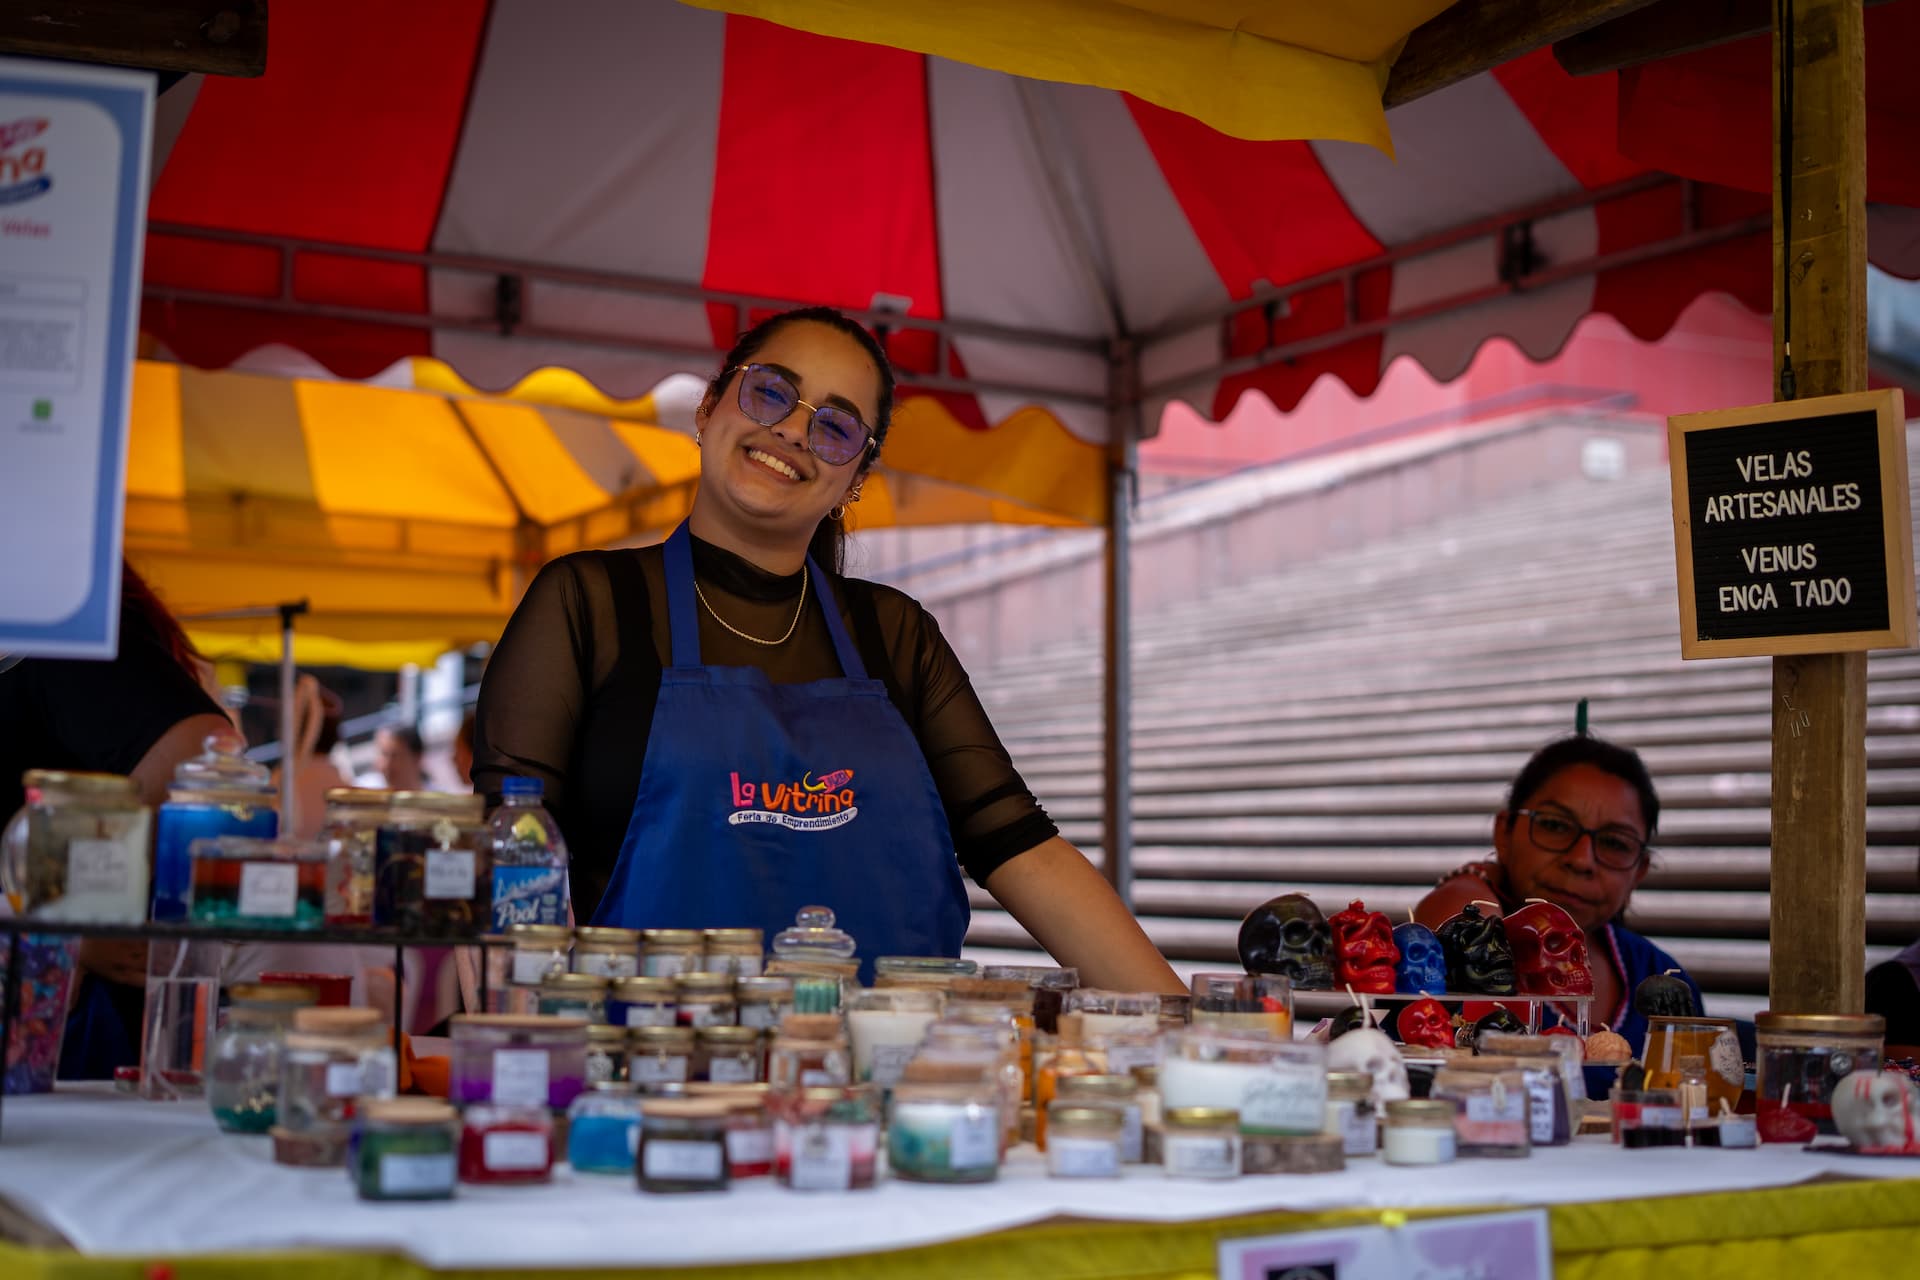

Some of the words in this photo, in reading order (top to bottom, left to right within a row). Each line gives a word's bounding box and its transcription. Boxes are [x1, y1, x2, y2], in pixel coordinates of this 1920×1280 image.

[1736, 450, 1813, 482] VELAS
[1704, 483, 1861, 523] ARTESANALES
[1741, 543, 1817, 574] VENUS
[1718, 582, 1778, 612] ENCA
[1790, 577, 1852, 607] TADO
[730, 771, 756, 807] La
[761, 782, 855, 813] Vitrina
[737, 813, 761, 823] Feria
[766, 813, 778, 824] de
[782, 813, 849, 829] Emprendimiento
